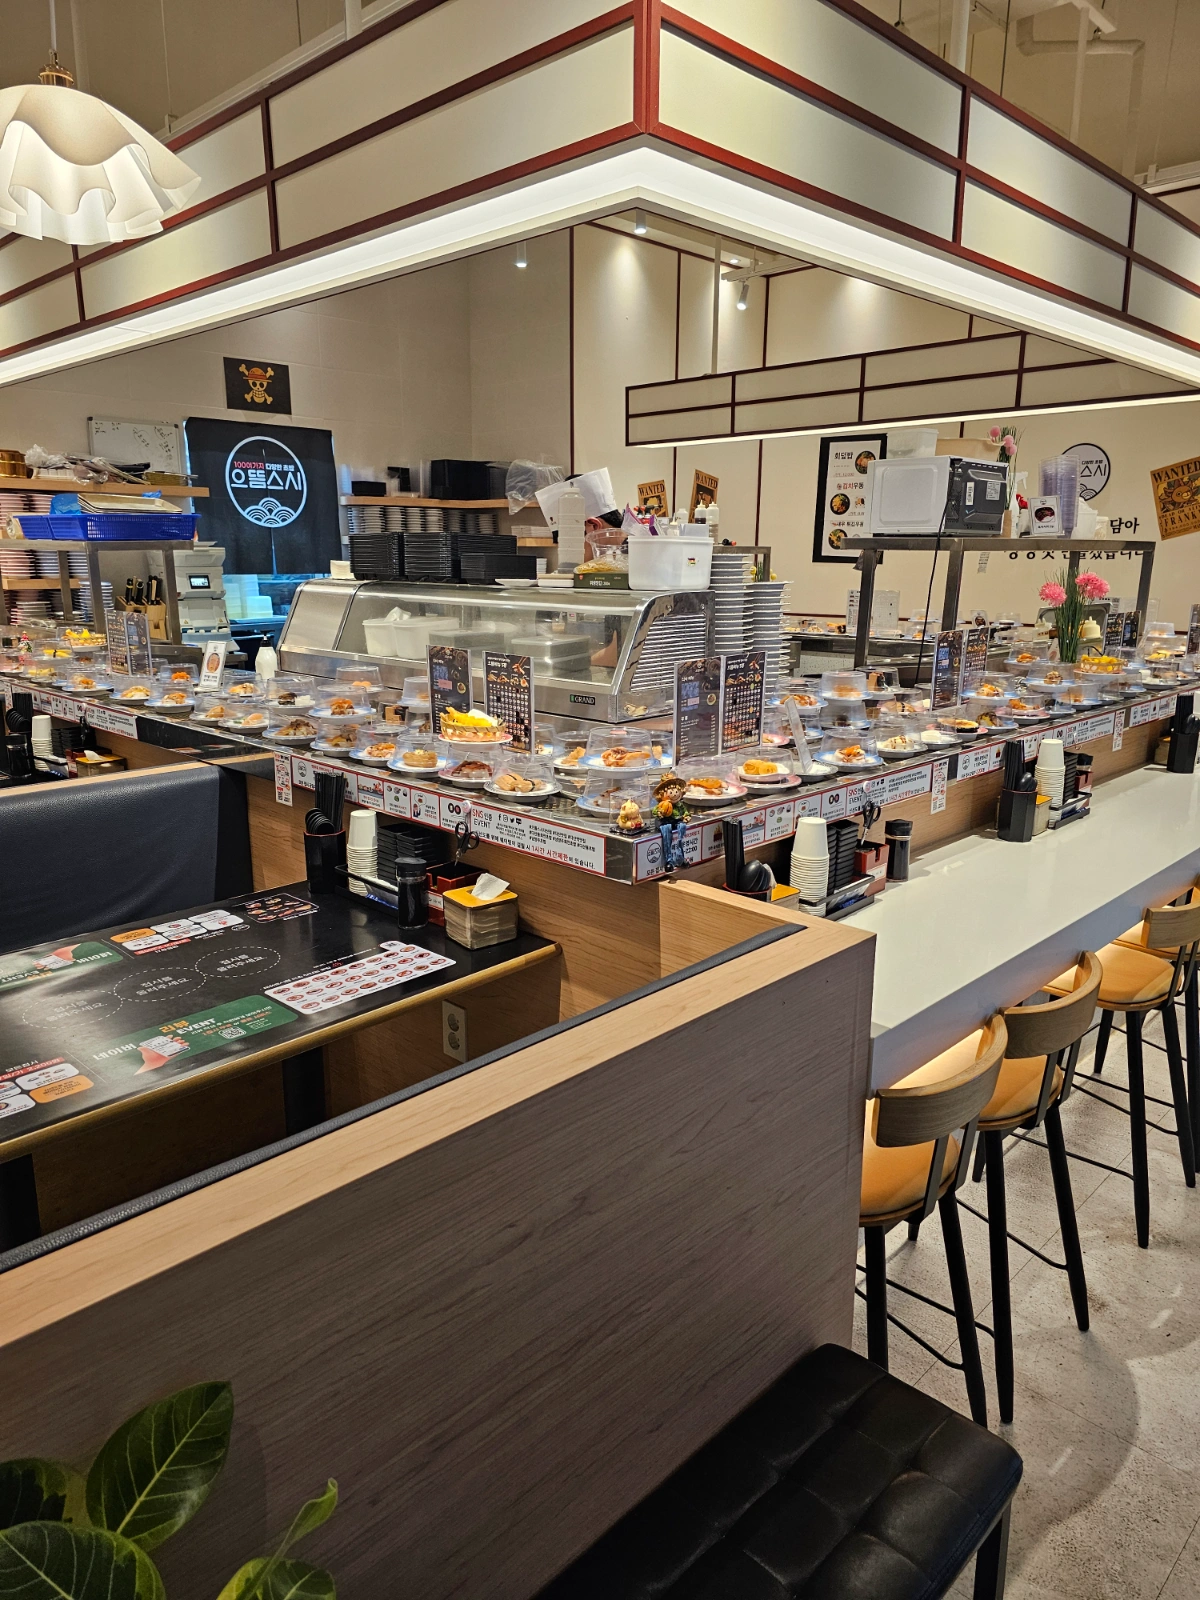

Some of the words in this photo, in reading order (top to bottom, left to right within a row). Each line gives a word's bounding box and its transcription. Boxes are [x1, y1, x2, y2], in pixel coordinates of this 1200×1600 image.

[230, 468, 302, 491] 으뜸스시
[1152, 460, 1200, 483] WANTED
[638, 483, 665, 497] WANTED
[695, 472, 718, 490] WANTED
[1109, 517, 1140, 535] 담아
[574, 696, 595, 705] GRAND
[472, 808, 484, 818] SNS
[473, 818, 491, 828] EVENT
[531, 845, 545, 855] 1시간
[175, 1017, 217, 1036] EVENT
[93, 1043, 138, 1061] 네이버
